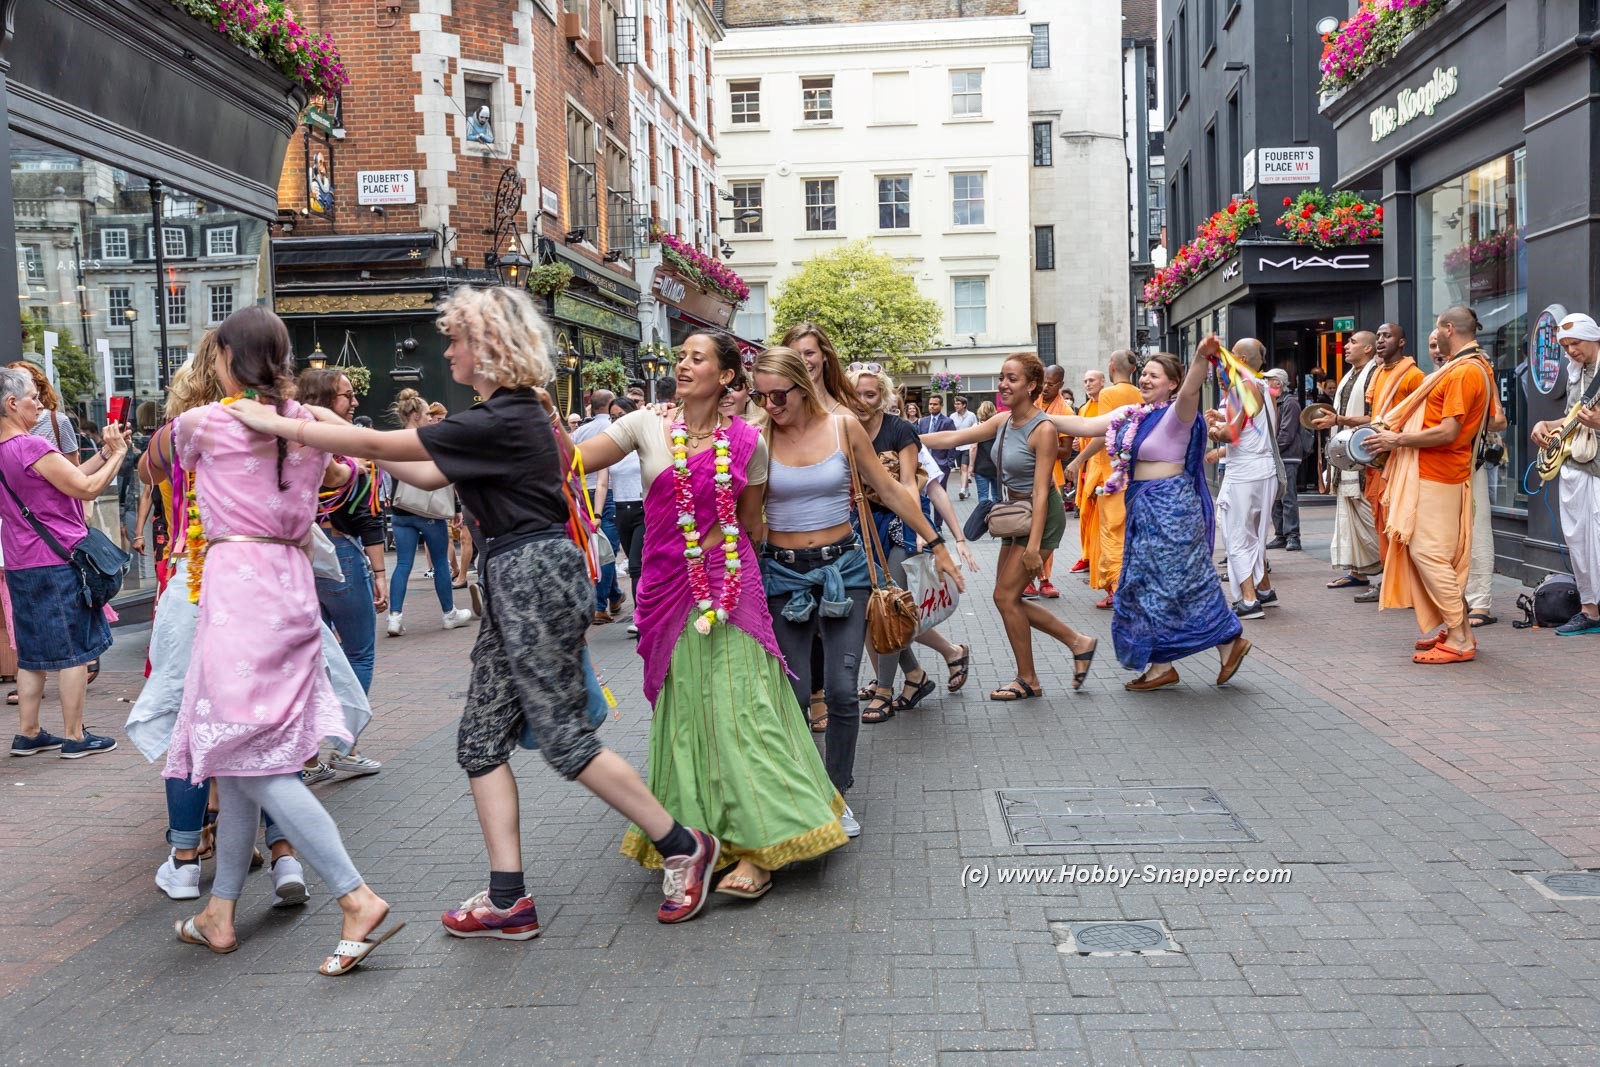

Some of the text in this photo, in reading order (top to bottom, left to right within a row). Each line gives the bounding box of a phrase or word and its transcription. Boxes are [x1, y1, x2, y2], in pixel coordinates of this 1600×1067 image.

[1369, 66, 1458, 142] The Kooples
[1264, 150, 1314, 161] FOUBERT'S
[1264, 162, 1309, 172] PLACE W1
[362, 173, 409, 183] FOUBERT'S
[363, 184, 405, 193] PLACE W1
[1222, 261, 1239, 283] MAC
